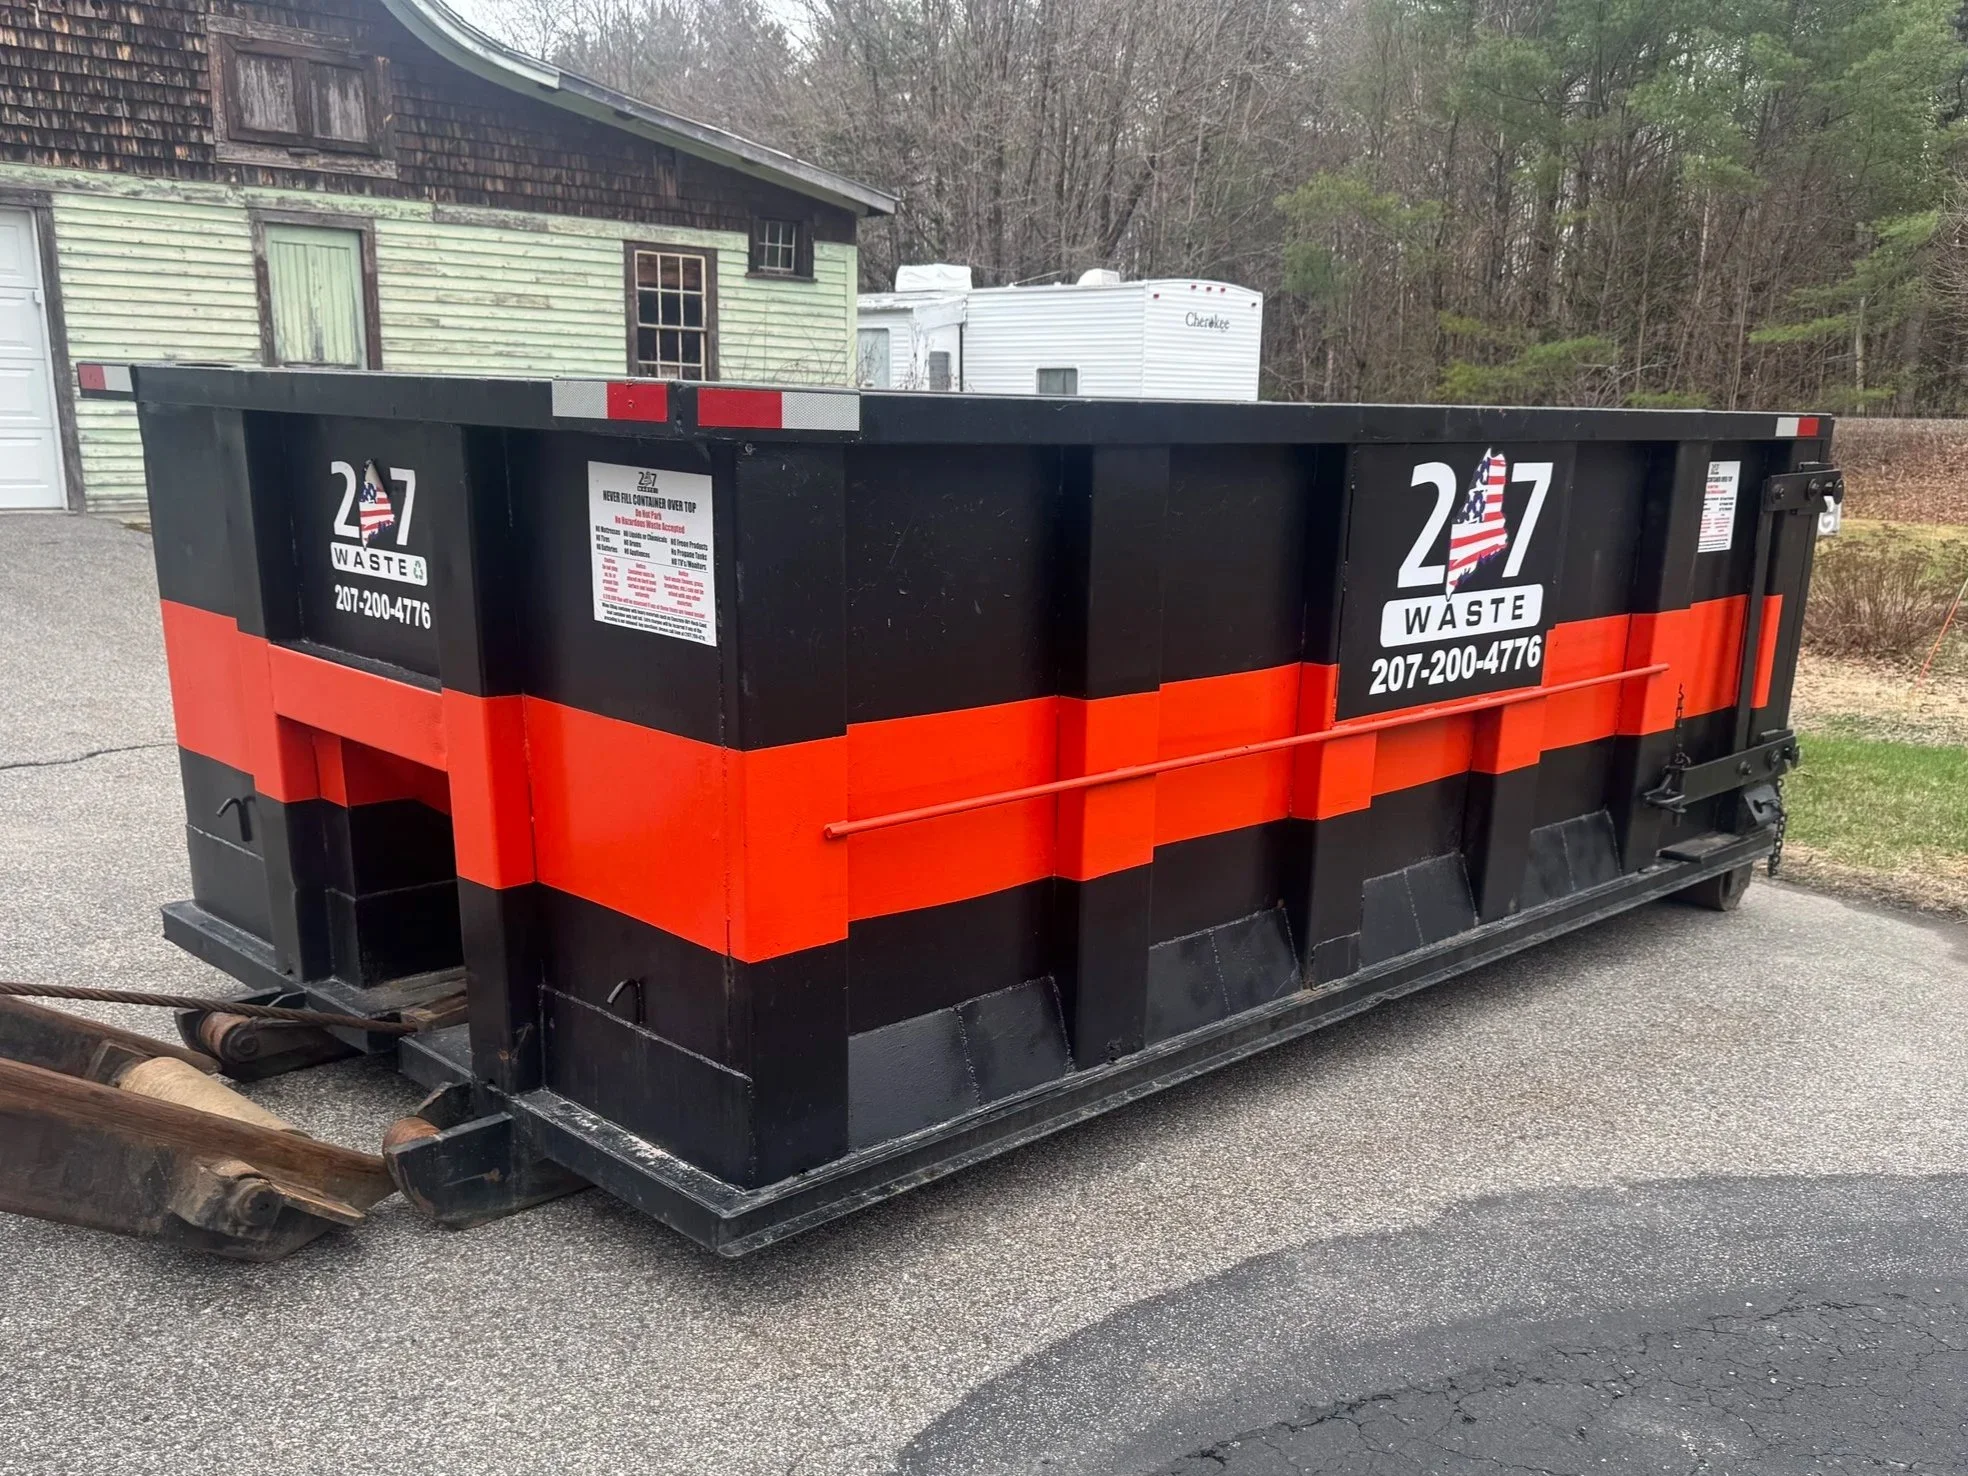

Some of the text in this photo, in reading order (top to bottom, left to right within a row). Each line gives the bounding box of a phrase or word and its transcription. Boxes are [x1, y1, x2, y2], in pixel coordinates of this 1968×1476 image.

[1185, 312, 1230, 330] Cherokee
[603, 490, 697, 514] NEVER FILL CONTAINER OVER TOP
[622, 517, 645, 528] Hazardous
[646, 520, 661, 531] Waste
[662, 523, 685, 534] Accepted
[334, 547, 407, 577] WASTE
[335, 584, 432, 629] 207-200-4776
[1404, 594, 1525, 635] WASTE
[1369, 634, 1543, 695] 207-200-4776
